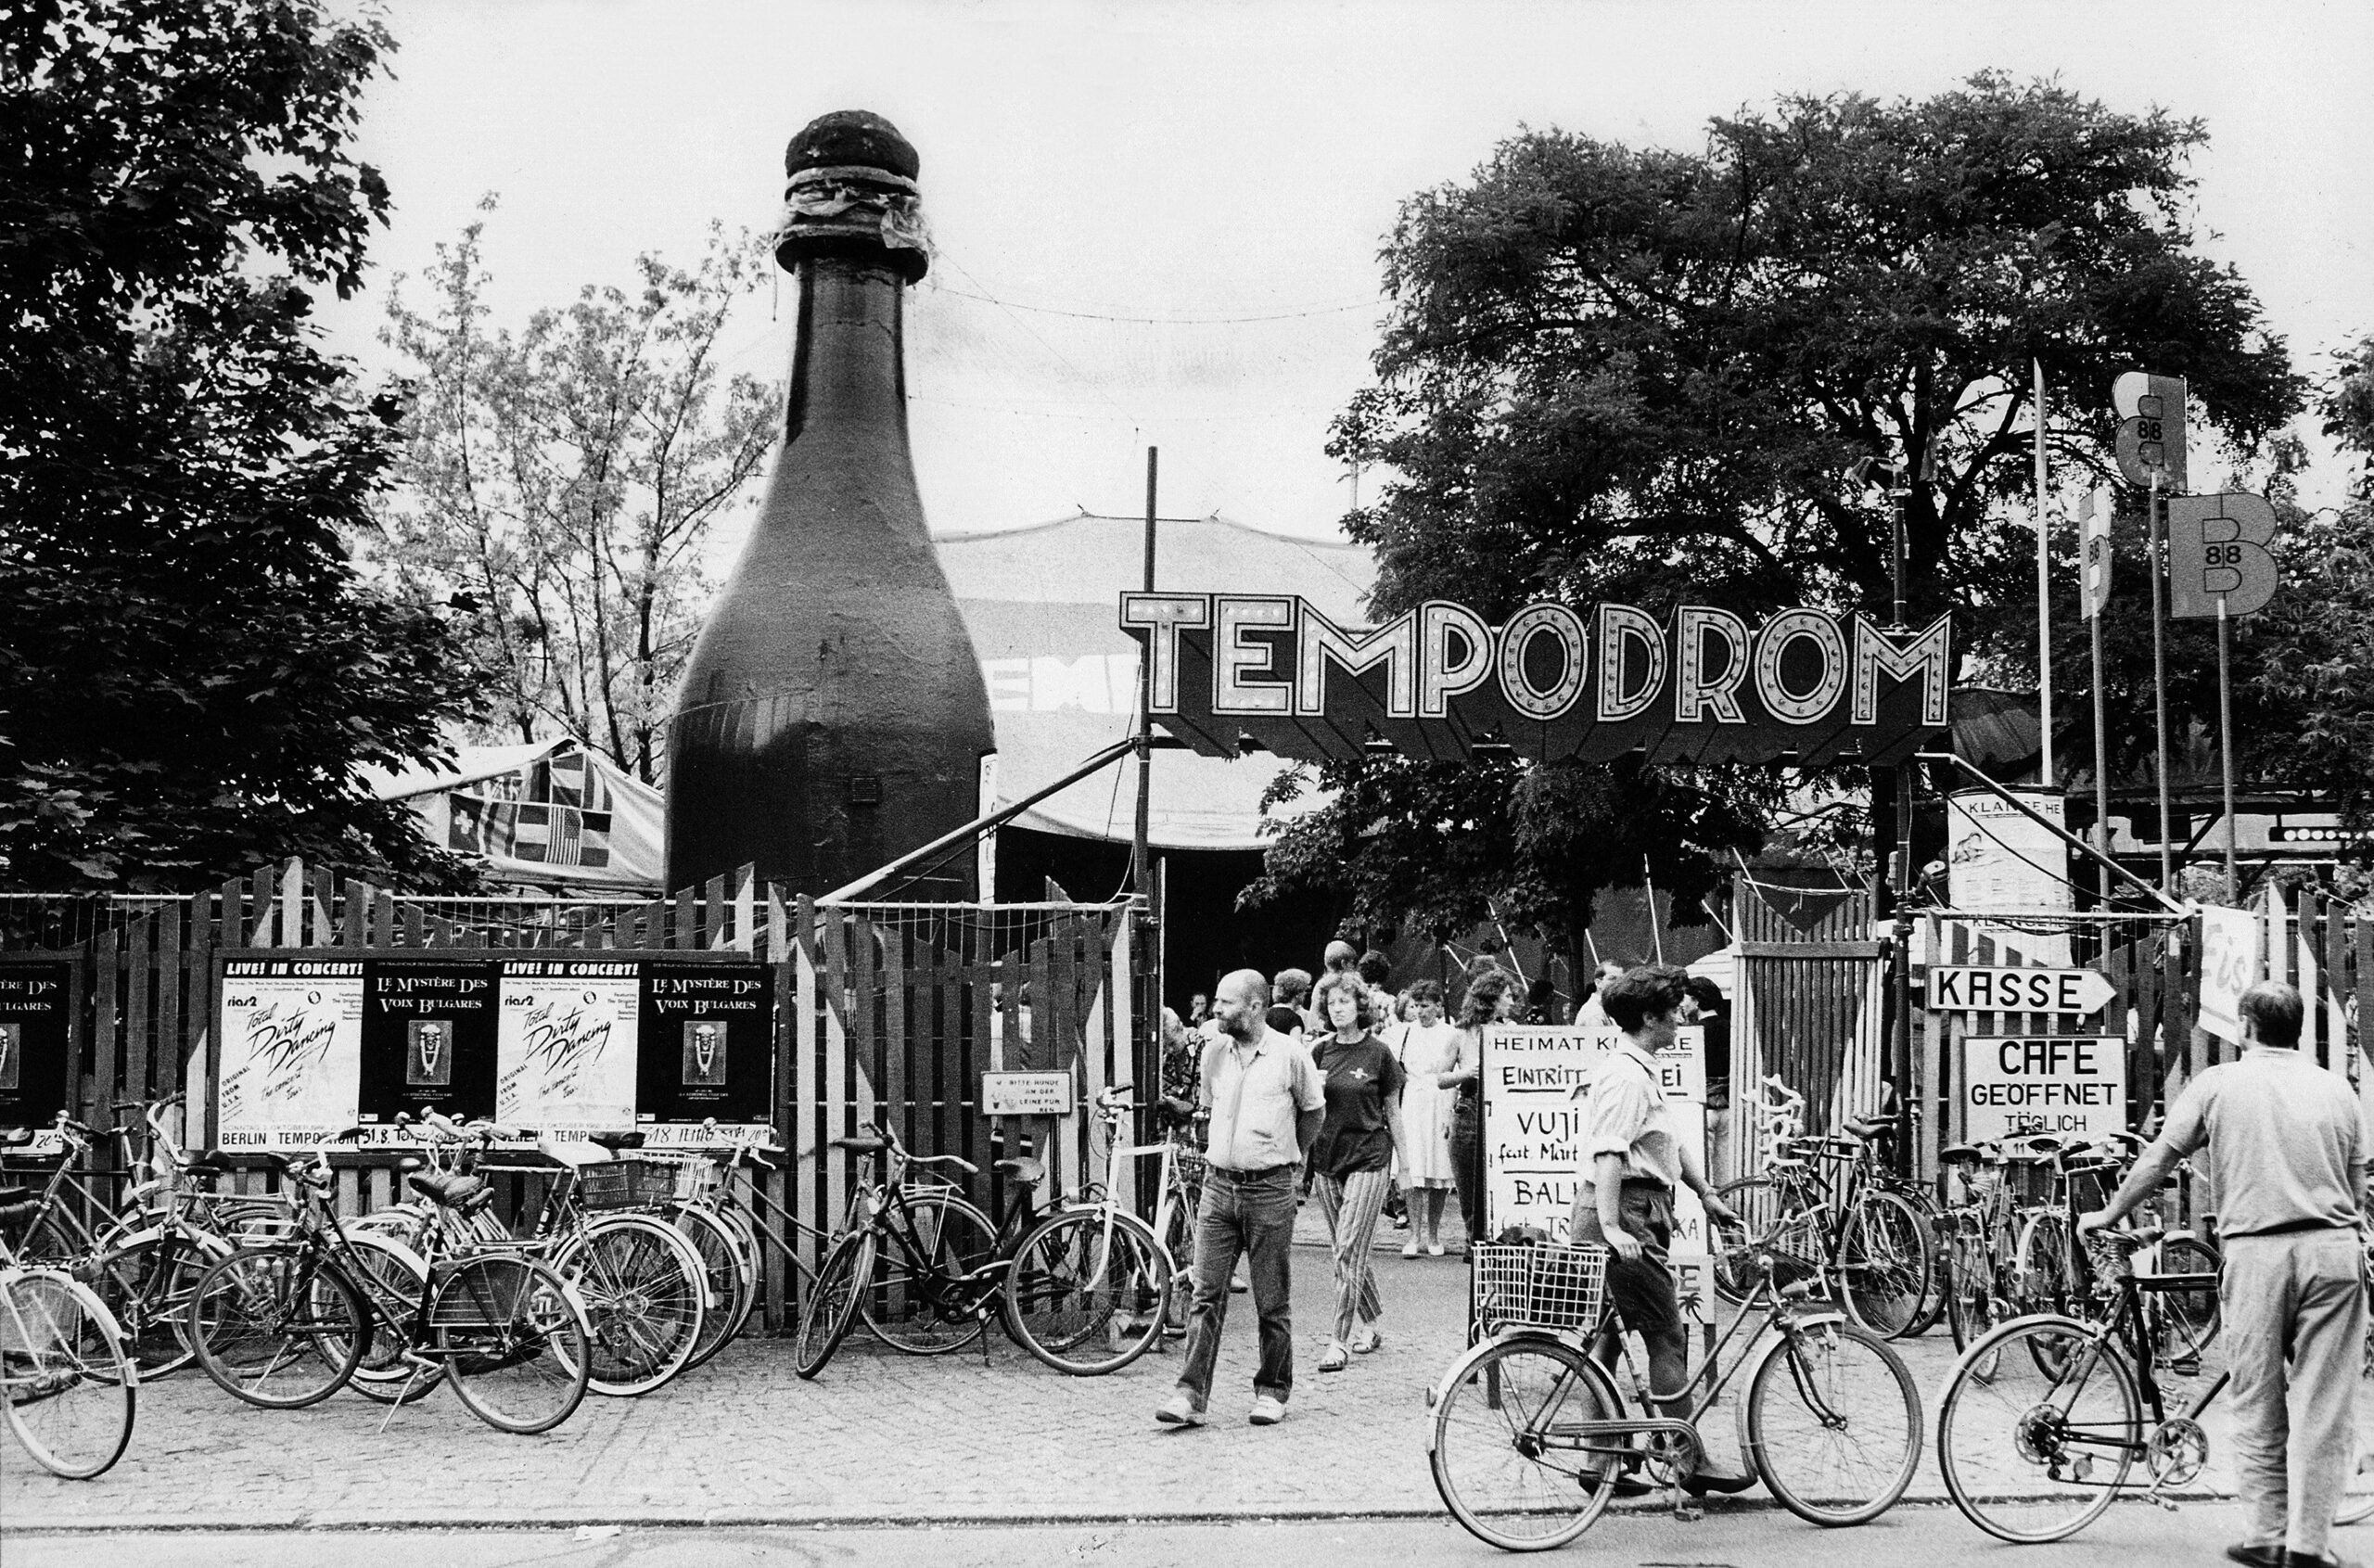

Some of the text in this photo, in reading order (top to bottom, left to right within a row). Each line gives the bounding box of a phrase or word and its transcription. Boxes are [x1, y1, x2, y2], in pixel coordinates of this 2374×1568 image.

[2205, 545, 2242, 565] 88
[1120, 592, 1952, 726] TEMPODROM
[226, 962, 364, 975] LIVE! IN CONCERT!
[504, 962, 639, 975] LIVE! IN CONCERT!
[1938, 971, 2083, 1009] KASSE
[246, 1007, 309, 1061] Dirty
[523, 1007, 584, 1061] Dirty
[1494, 1037, 1585, 1051] HEIMAT
[263, 1019, 336, 1077] Dancing
[541, 1019, 612, 1076] Dancing
[1999, 1040, 2098, 1075] CAFE
[222, 1065, 250, 1087] ORIGINAL
[500, 1064, 528, 1084] ORIGINAL
[222, 1084, 240, 1098] FROM
[500, 1082, 517, 1095] FROM
[223, 1133, 266, 1145] BERLIN
[555, 1130, 588, 1142] TEMP
[1546, 1217, 1571, 1238] TR
